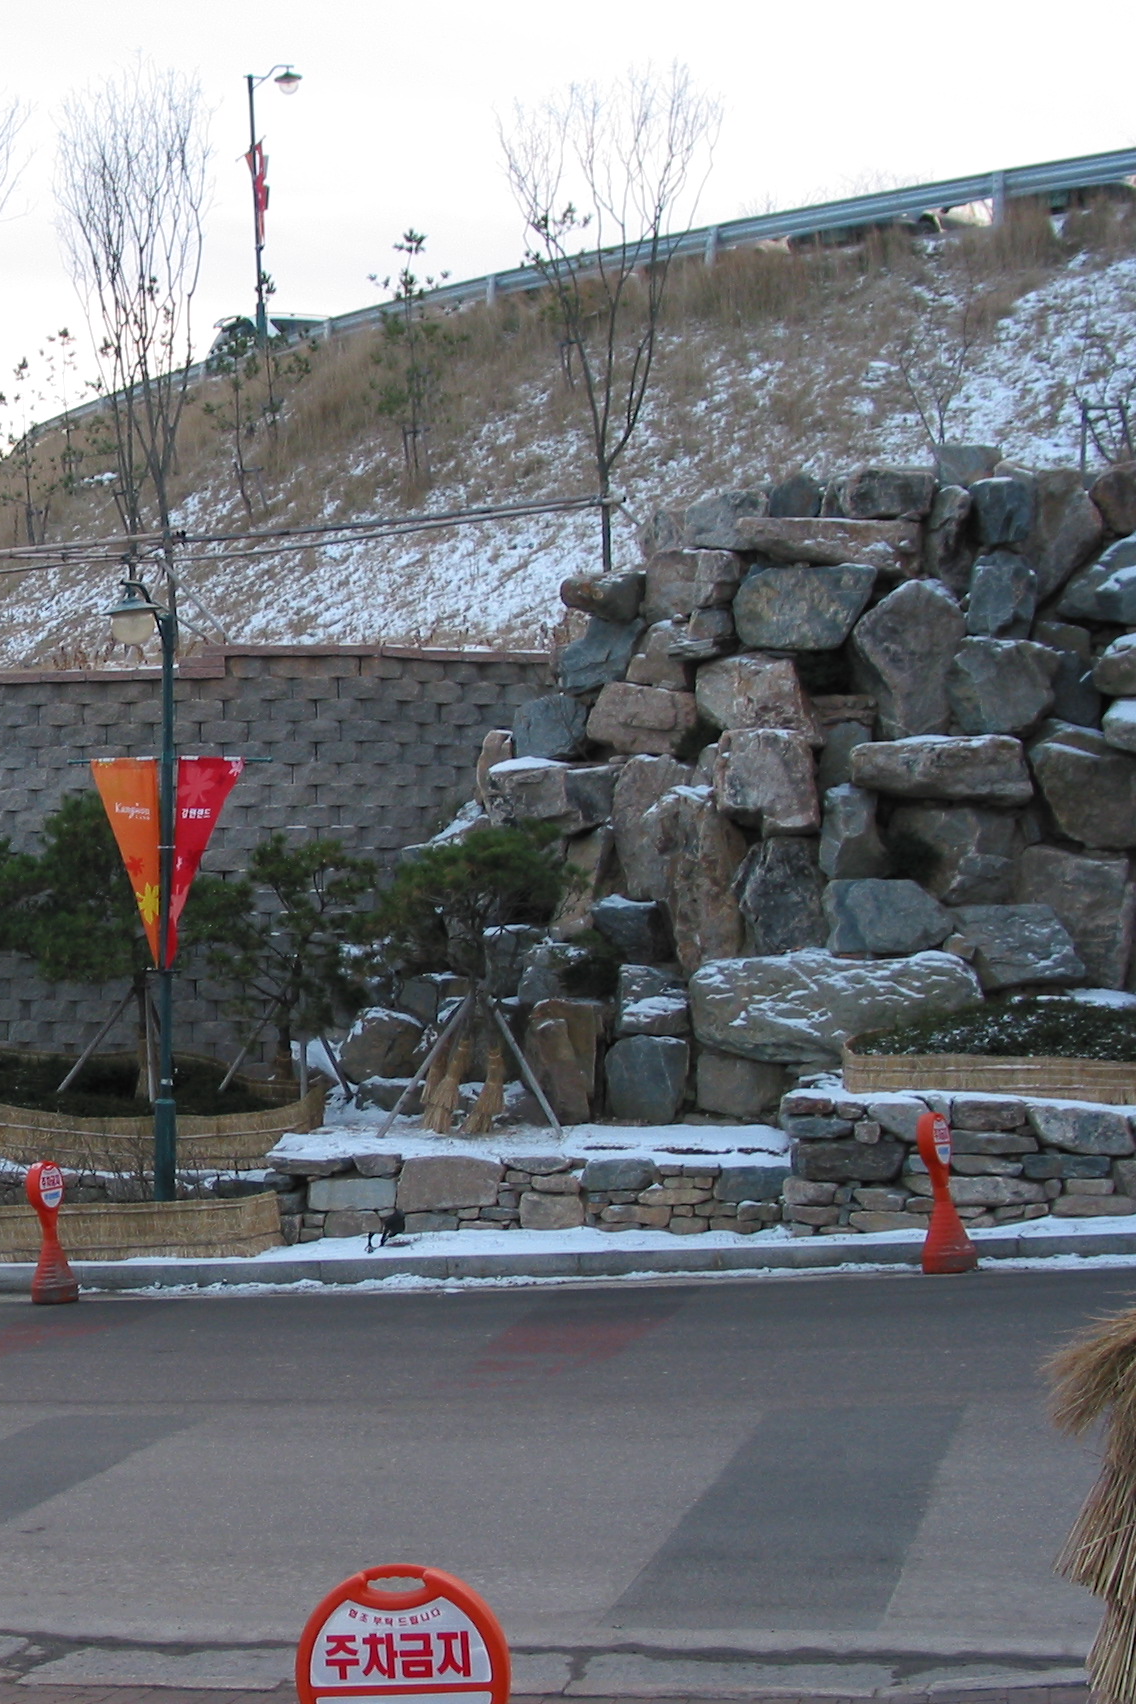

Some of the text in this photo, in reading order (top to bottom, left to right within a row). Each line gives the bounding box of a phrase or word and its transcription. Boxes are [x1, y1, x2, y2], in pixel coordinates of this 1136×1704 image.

[348, 1607, 441, 1627] 협조 부탁 드립니다
[325, 1631, 471, 1680] 주차금지
